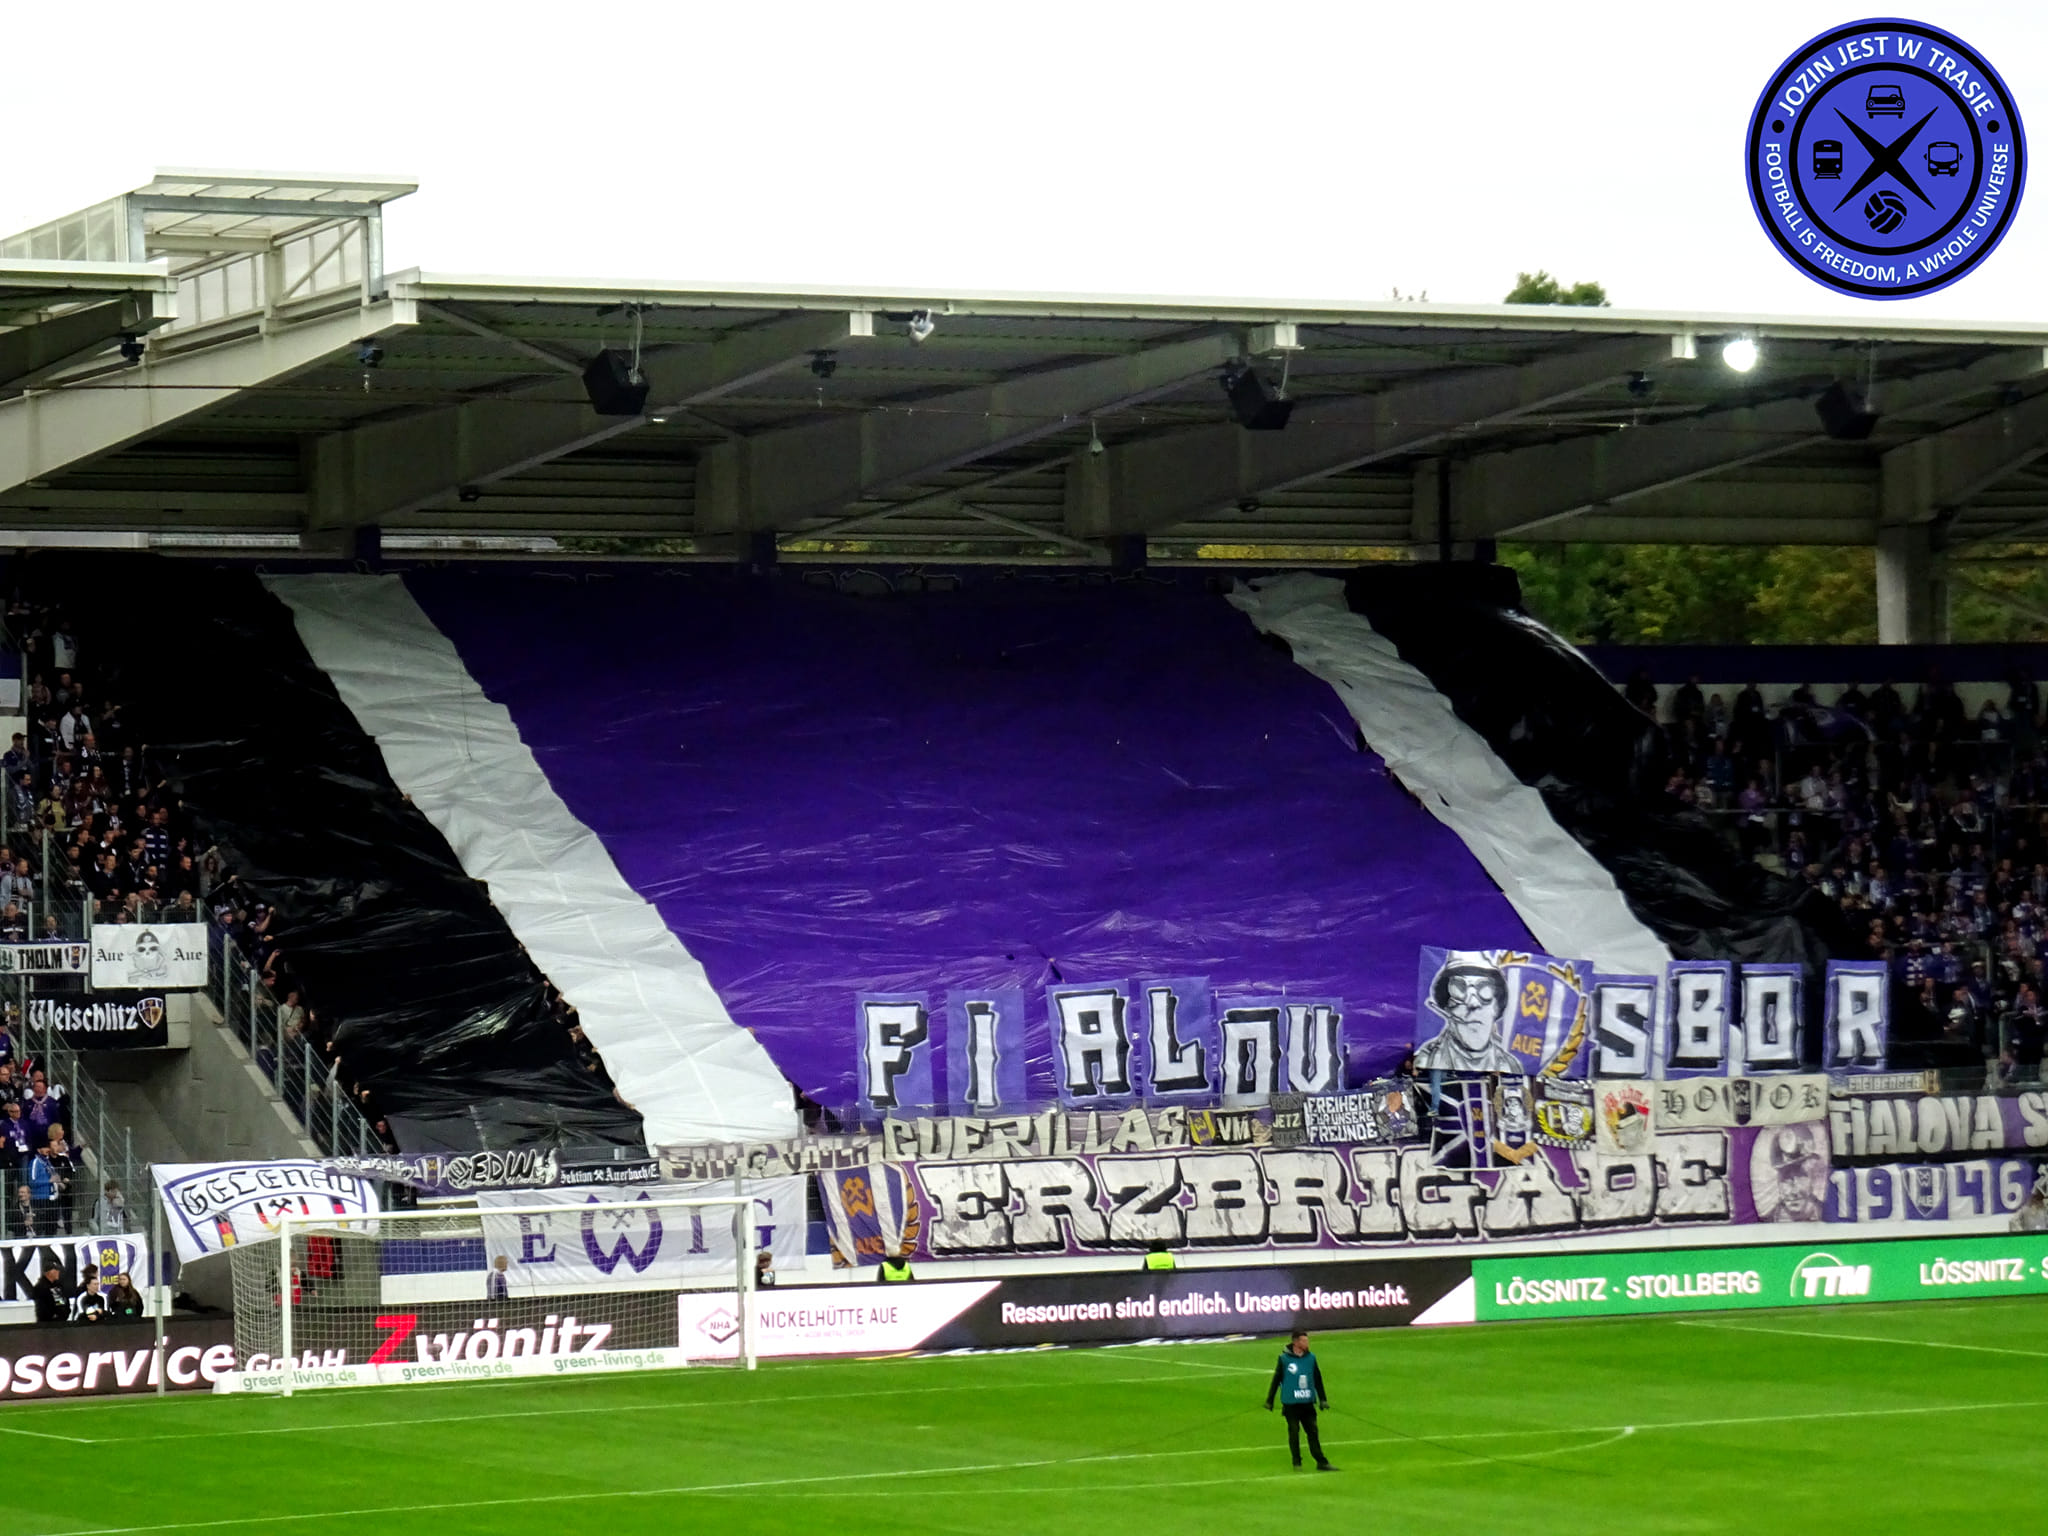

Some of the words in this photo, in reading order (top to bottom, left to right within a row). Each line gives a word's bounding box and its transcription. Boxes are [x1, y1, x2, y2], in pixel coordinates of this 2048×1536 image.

[18, 948, 63, 970] THOLM
[96, 948, 124, 963] Aue
[173, 947, 203, 962] Aue
[29, 999, 138, 1032] Weischlitz
[1593, 966, 1886, 1079] SBOR
[1510, 1034, 1543, 1057] AUE
[884, 1105, 1188, 1162] GUERILLAS
[1307, 1122, 1378, 1144] FREUNDE
[916, 1131, 1731, 1257] ERZBRIGADE
[1801, 1264, 1871, 1297] TTM
[1920, 1257, 2025, 1285] LÖSSNITZ
[1495, 1276, 1607, 1306] LÖSSNITZ
[1625, 1270, 1760, 1299] STOLLBERG
[760, 1305, 865, 1329] NICKELHÜTTE
[869, 1306, 898, 1325] AUE
[1002, 1300, 1113, 1325] Ressourcen
[1115, 1295, 1156, 1319] sind
[1158, 1294, 1231, 1317] endlich.
[1235, 1291, 1301, 1313] Unsere
[1303, 1287, 1355, 1310] Ideen
[1357, 1283, 1409, 1307] nicht.
[366, 1313, 613, 1366] Zwönitz
[401, 1361, 513, 1382] green-living.de
[554, 1350, 666, 1373] green-living.de
